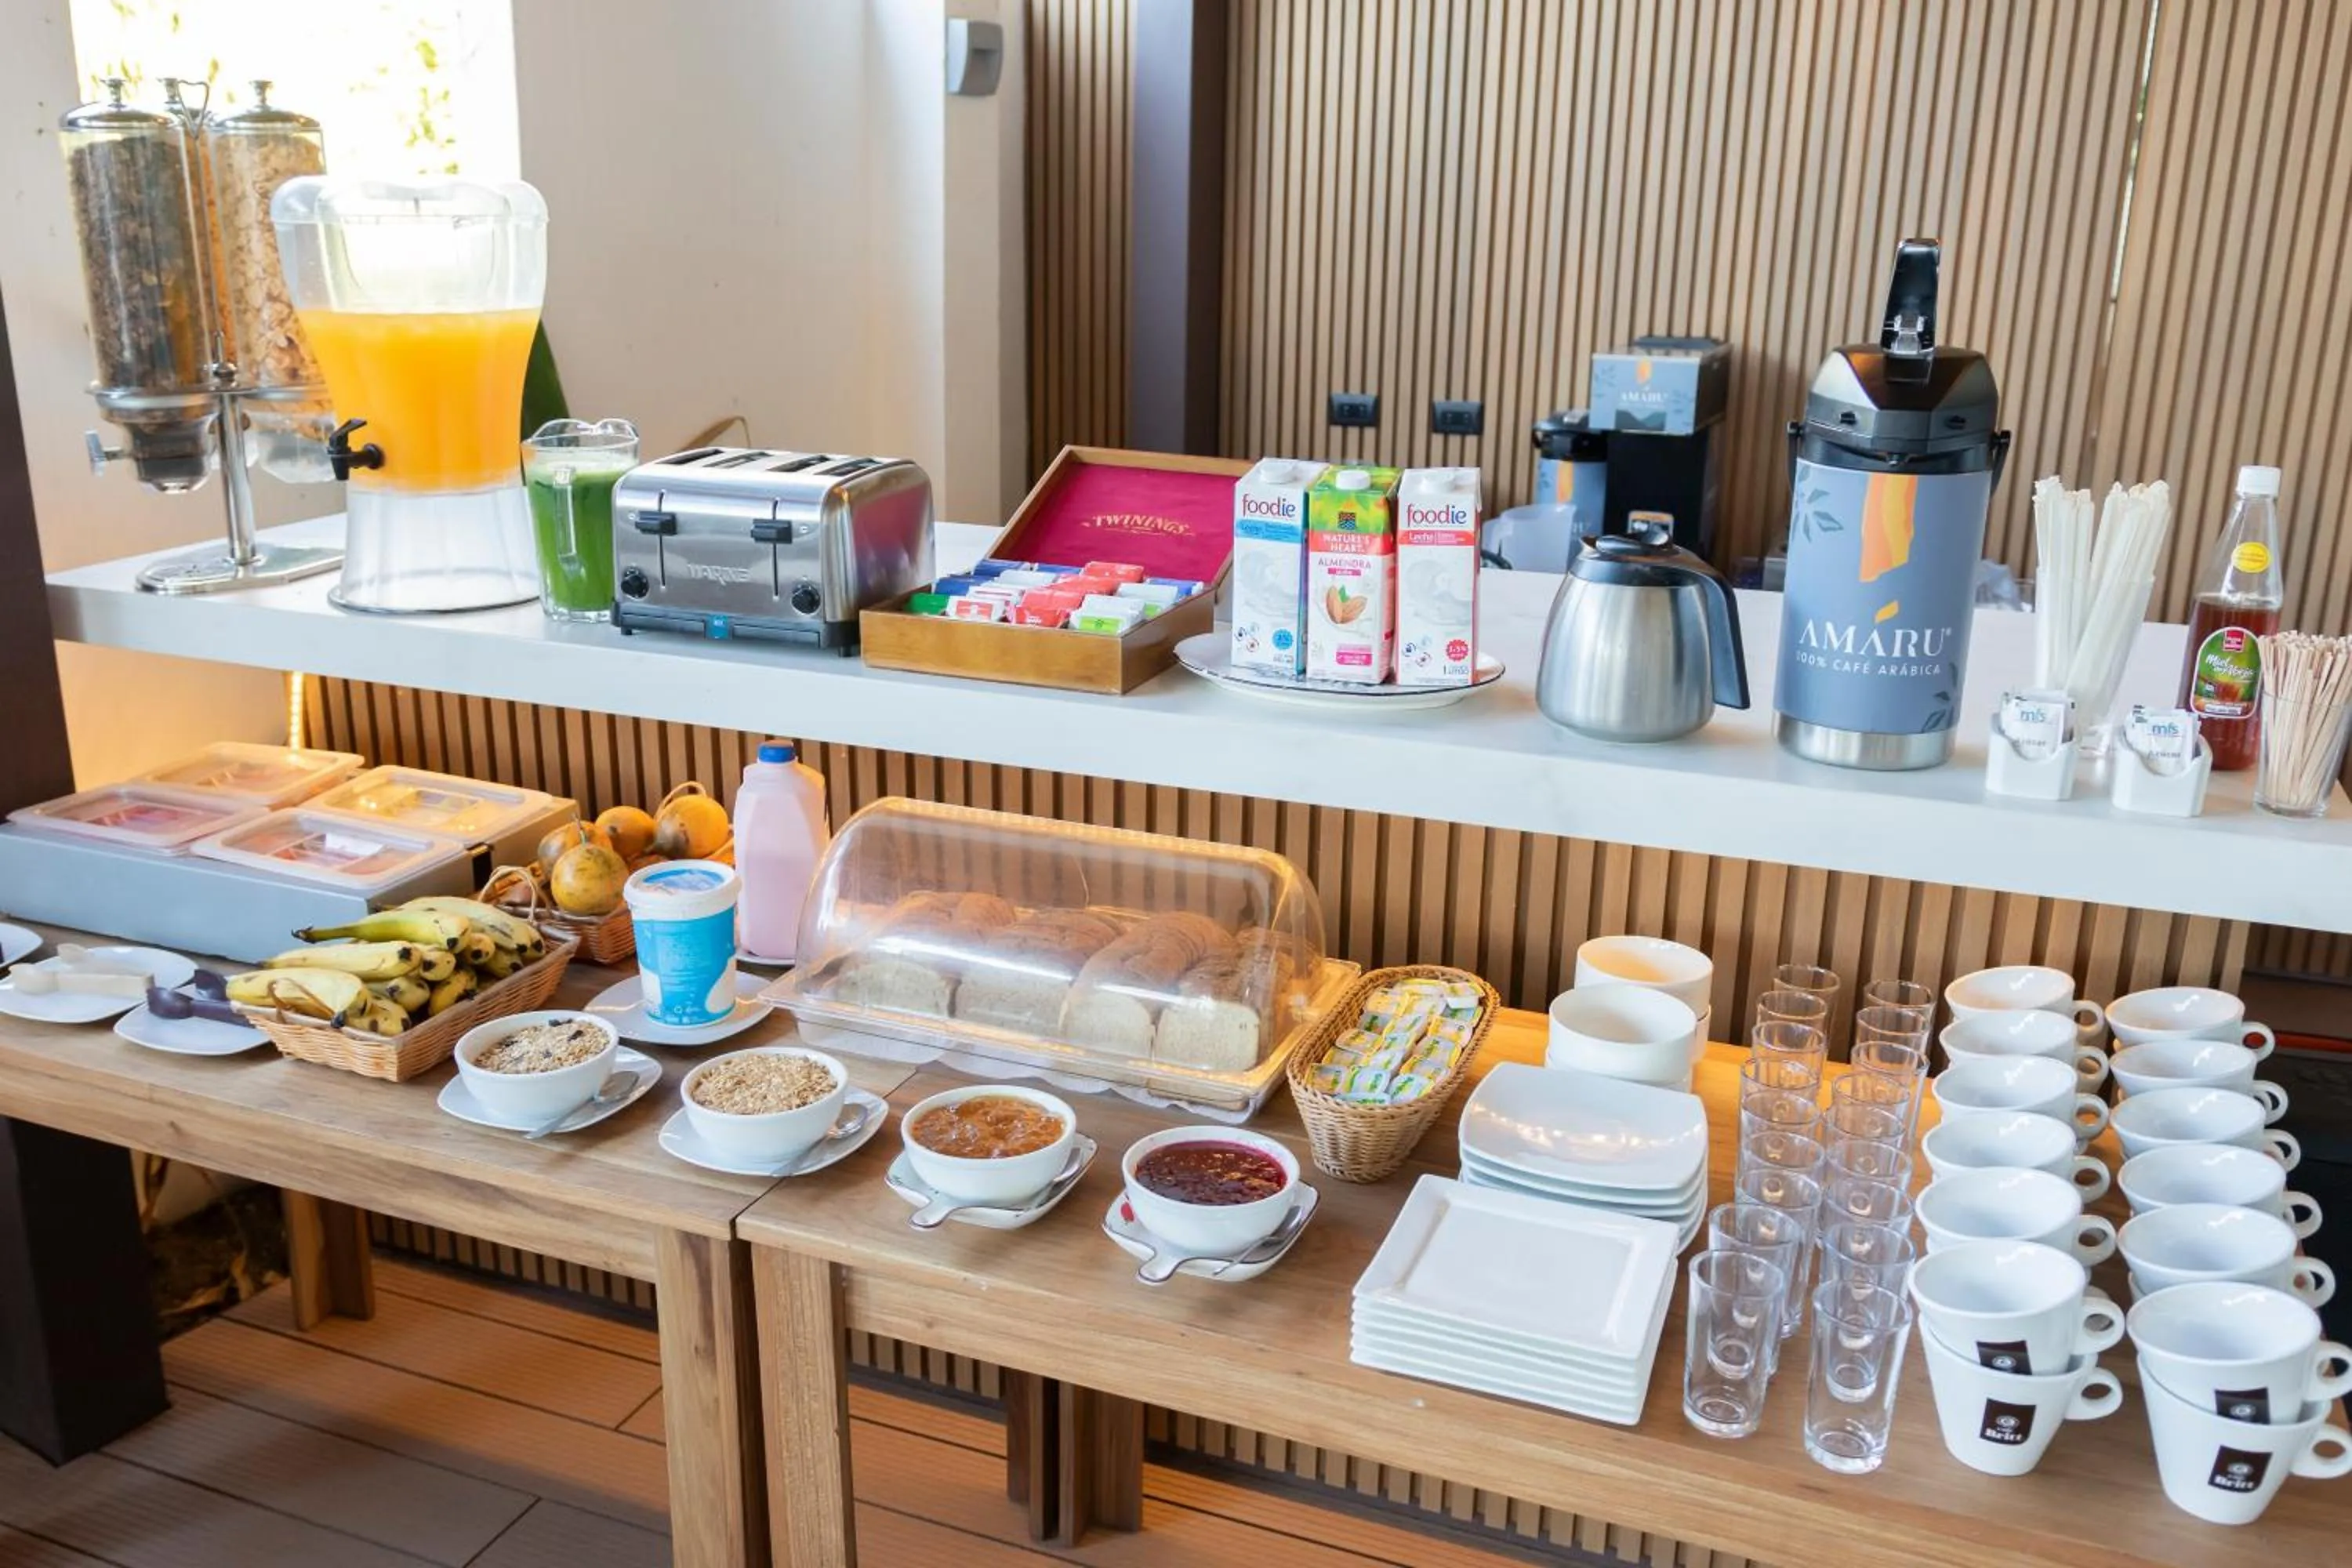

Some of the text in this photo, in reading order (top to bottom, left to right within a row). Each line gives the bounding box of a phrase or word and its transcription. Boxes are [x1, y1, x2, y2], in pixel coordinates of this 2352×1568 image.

[1242, 493, 1296, 517] foodie
[1406, 503, 1467, 527] foodie
[1092, 514, 1189, 534] TWININGS
[1318, 557, 1372, 568] ALMENDRA
[1832, 659, 1870, 675] CAFÉ
[1878, 663, 1941, 676] ARÁBICA
[2152, 722, 2179, 735] mfs
[1984, 1428, 2023, 1441] Britt
